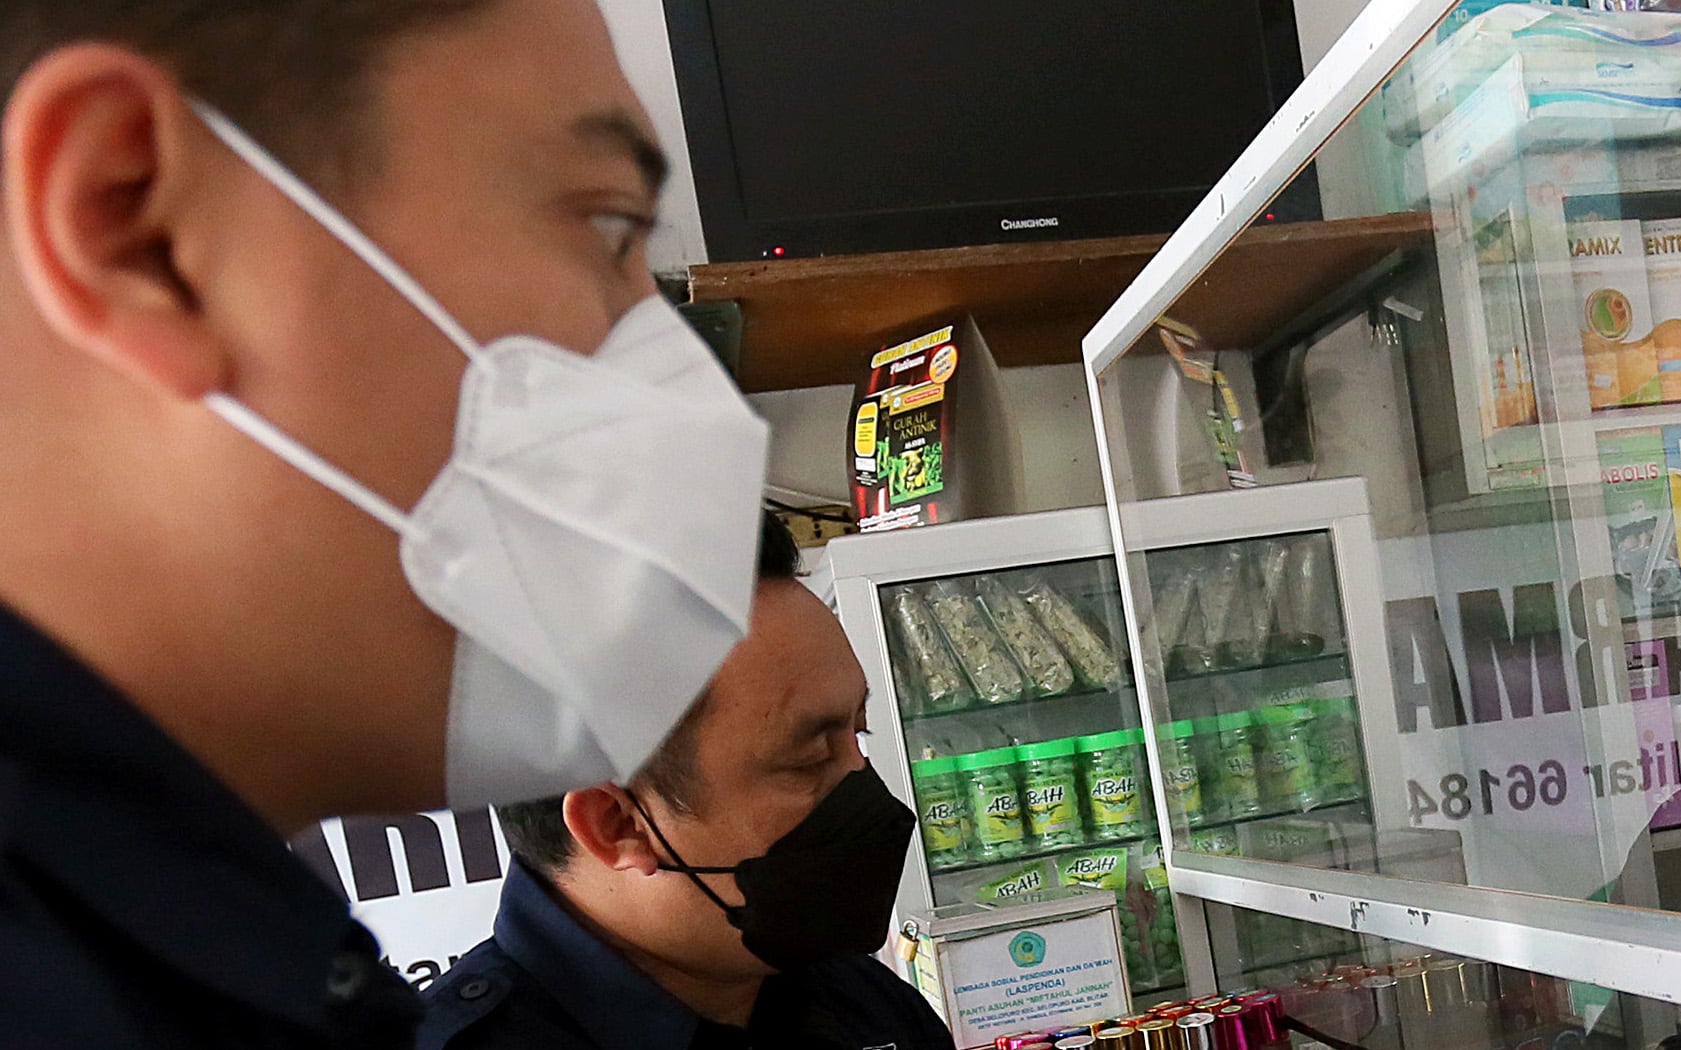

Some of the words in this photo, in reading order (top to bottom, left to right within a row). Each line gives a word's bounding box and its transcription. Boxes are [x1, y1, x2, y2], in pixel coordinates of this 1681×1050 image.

[1000, 217, 1059, 231] CHANGHONG
[893, 411, 928, 431] GURAH
[899, 419, 937, 441] ANTINIK
[1091, 775, 1136, 797] ABAH
[1065, 855, 1118, 875] ABAH
[996, 871, 1041, 898] ABAH
[953, 982, 990, 995] LEMBAGA
[991, 976, 1018, 988] SOSIAL
[1020, 967, 1065, 982] PENDIDIKAN
[1066, 964, 1081, 974] DAN
[1005, 978, 1066, 998] (LASPENDA)
[959, 1004, 986, 1018] PANTI
[988, 999, 1025, 1013] ASUHAN
